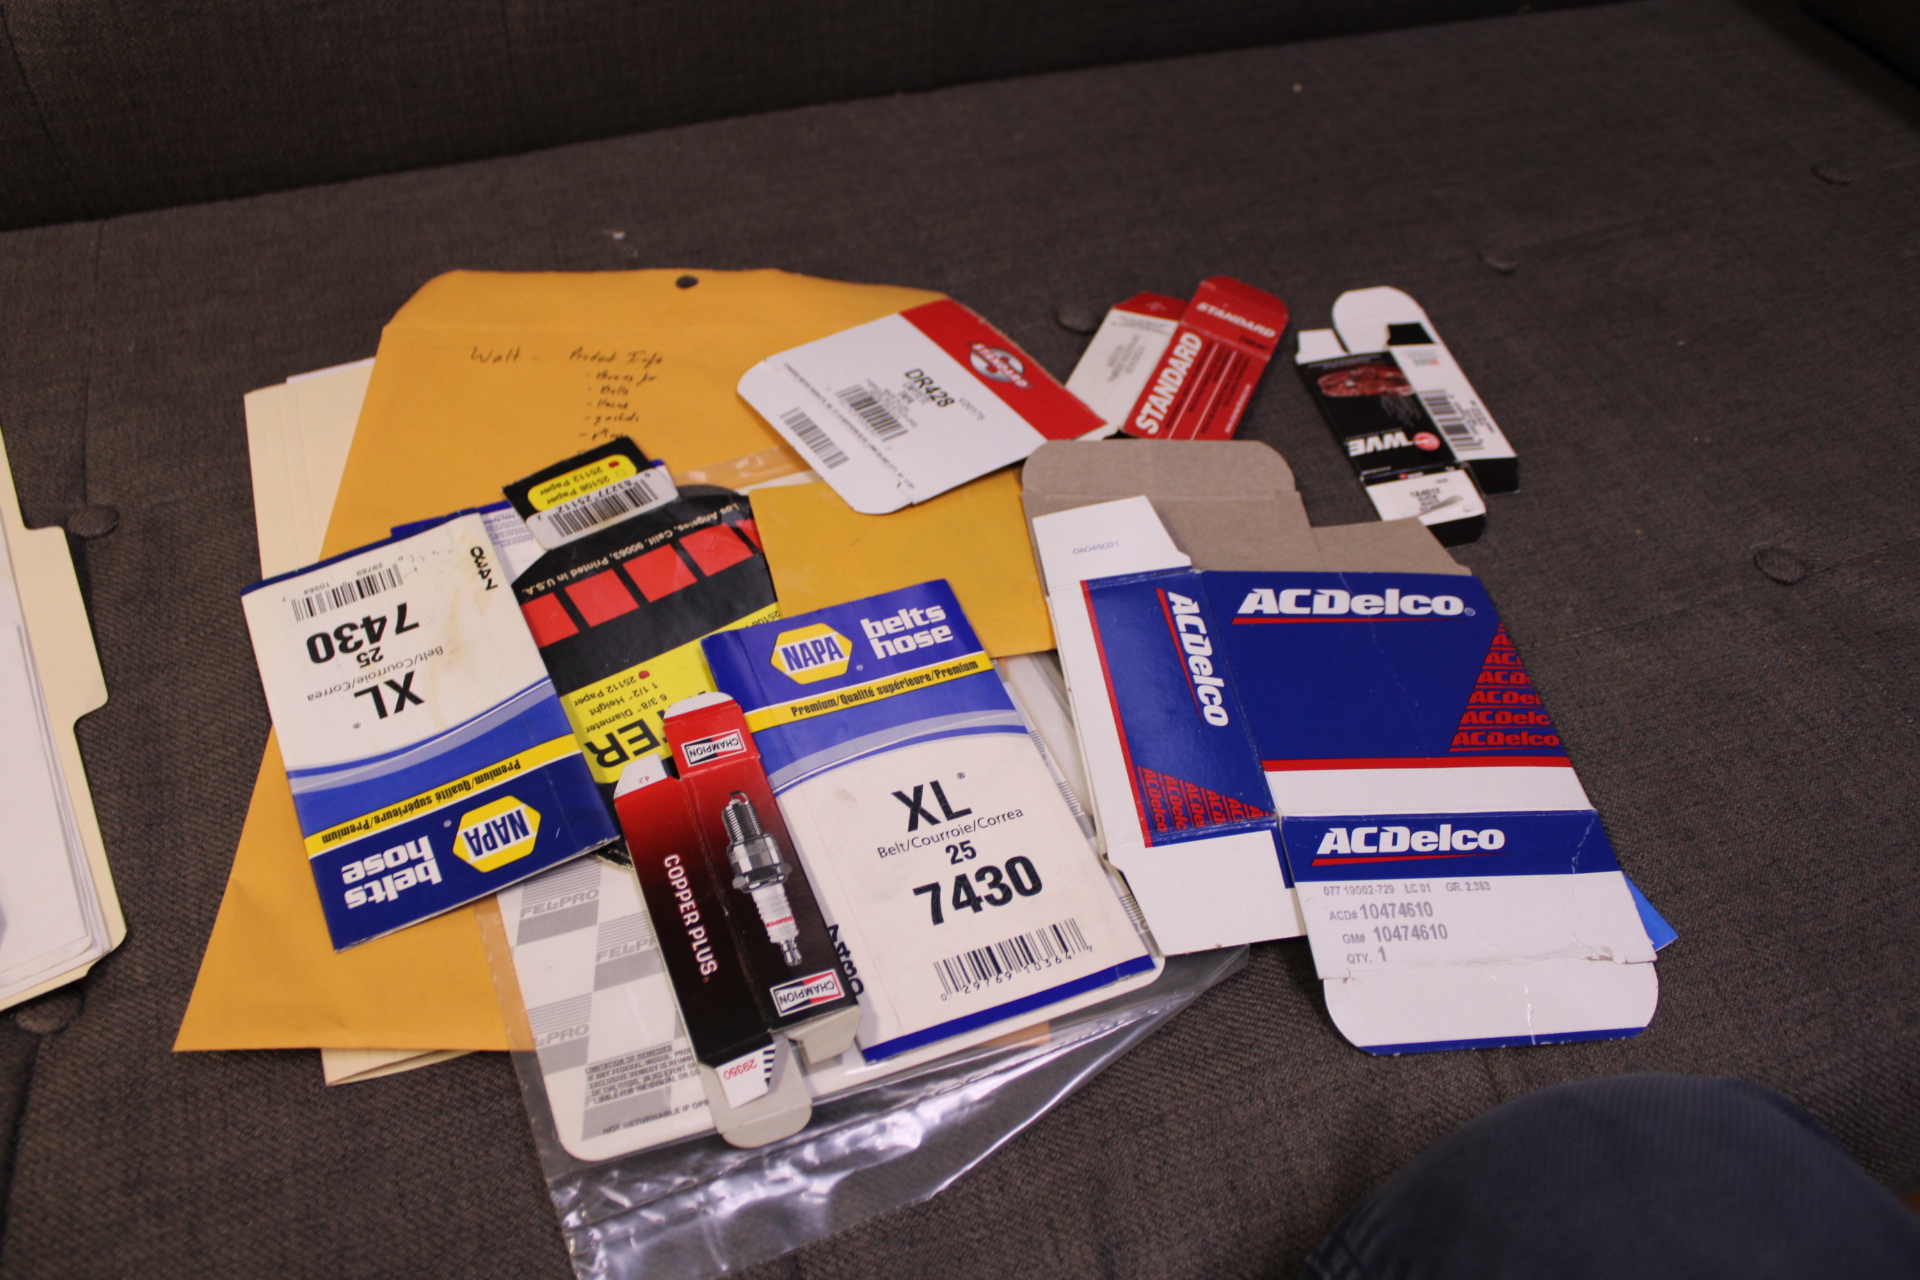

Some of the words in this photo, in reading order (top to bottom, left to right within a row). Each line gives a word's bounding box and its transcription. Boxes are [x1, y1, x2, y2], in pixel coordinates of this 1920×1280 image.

[1196, 302, 1276, 338] STANDARD
[971, 343, 1030, 388] STANDARD
[904, 368, 955, 409] DR428
[1135, 332, 1202, 434] STANDARD
[1348, 431, 1411, 457] WVE
[540, 479, 570, 495] Paper
[573, 466, 603, 482] 25112
[547, 488, 577, 504] Paper
[558, 495, 591, 513] 25112
[470, 546, 498, 592] 7430
[557, 572, 569, 583] in
[570, 556, 609, 577] Printed
[521, 578, 556, 596] U.S.A.
[1237, 588, 1465, 615] ACDelco
[306, 602, 420, 665] 7430
[860, 605, 947, 640] belts
[356, 646, 384, 669] 25
[781, 635, 845, 672] NAPA
[870, 625, 953, 660] hose
[307, 645, 444, 702] Belt/Courroie/Correa
[1168, 591, 1229, 727] ACDelco
[354, 670, 425, 720] XL
[573, 691, 604, 708] Paper
[606, 676, 637, 694] 25112
[790, 687, 875, 717] Premium/Qualité
[876, 660, 979, 696] supérieure/Premium
[585, 708, 633, 733] Diameter
[589, 695, 625, 716] Height
[689, 737, 739, 758] CHAMPION
[1452, 731, 1559, 746] ACDelco
[435, 759, 521, 803] Premium/Qualité
[891, 780, 972, 833] XL
[1142, 768, 1168, 832] ACDelco
[322, 795, 433, 844] supérieure/Premium
[463, 809, 530, 858] NAPA
[877, 808, 1023, 858] Belt/Courroie/Correa
[945, 840, 977, 865] 25
[1316, 824, 1505, 854] ACDelco
[341, 835, 435, 884] hose
[344, 858, 442, 910] belts
[912, 855, 1043, 926] 7430
[1404, 883, 1418, 893] LC
[520, 889, 599, 918] FEL-PRO
[664, 854, 700, 926] COPPER
[688, 925, 718, 976] PLUS
[1329, 910, 1358, 921] ACD#
[1359, 901, 1434, 920] 10474610
[1342, 933, 1365, 944] GM#
[1373, 923, 1448, 942] 10474610
[1378, 946, 1387, 962] 1
[963, 971, 1012, 994] 29769
[1024, 951, 1072, 974] 10364
[780, 980, 835, 1006] CHAMPION
[602, 1124, 621, 1134] NOT
[623, 1107, 681, 1130] RETURNABLE
